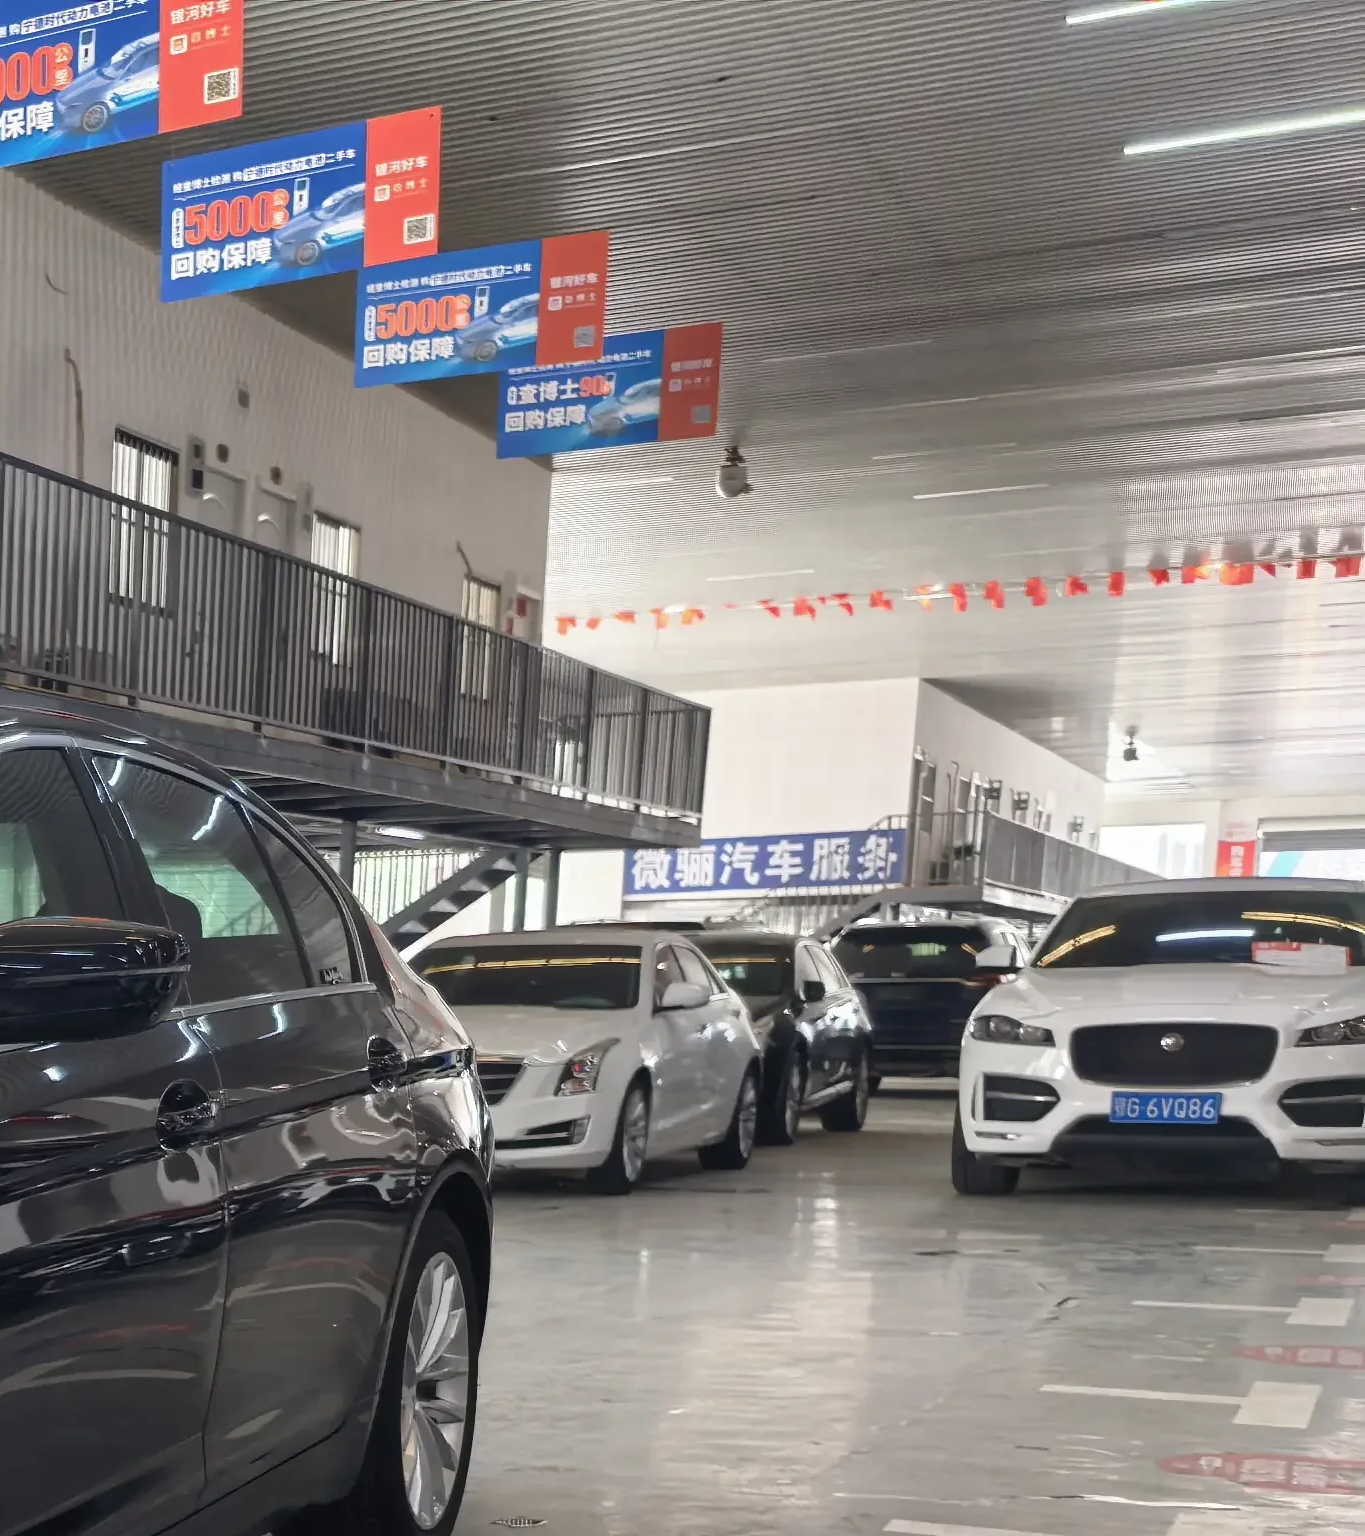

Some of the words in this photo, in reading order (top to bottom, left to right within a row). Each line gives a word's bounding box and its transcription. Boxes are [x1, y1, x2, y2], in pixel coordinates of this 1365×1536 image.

[170, 238, 273, 281] 回购保障
[363, 336, 455, 369] 回购保障
[505, 404, 586, 433] 回购保障
[630, 835, 898, 890] 微骊汽车服务
